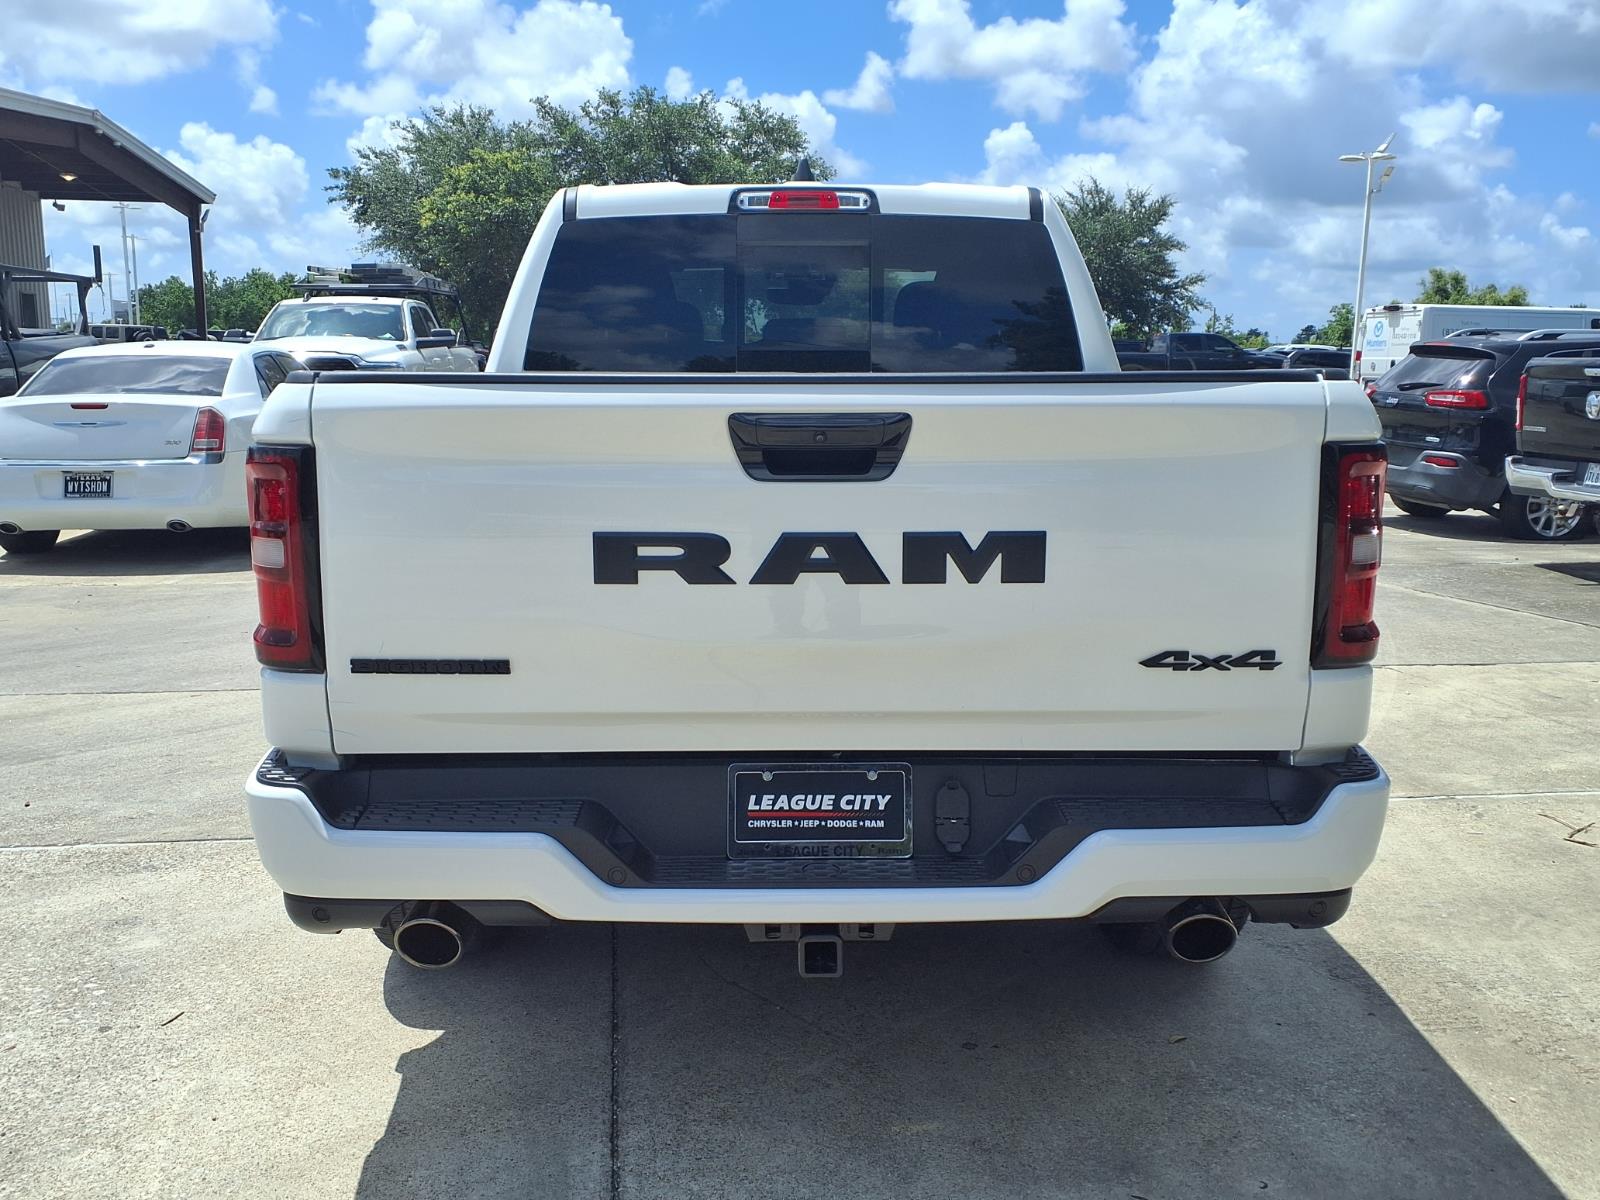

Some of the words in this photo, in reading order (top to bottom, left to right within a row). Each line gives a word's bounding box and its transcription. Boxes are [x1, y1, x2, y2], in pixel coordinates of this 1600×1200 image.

[592, 531, 1047, 585] RAM
[1138, 650, 1283, 671] 4x4
[747, 794, 835, 810] LEAGUE
[840, 794, 892, 810] CITY
[747, 820, 793, 828] CHRYSLER
[799, 820, 820, 828] JEEP
[827, 820, 858, 828] DODGE
[864, 820, 885, 828] RAM
[833, 845, 865, 856] CITY
